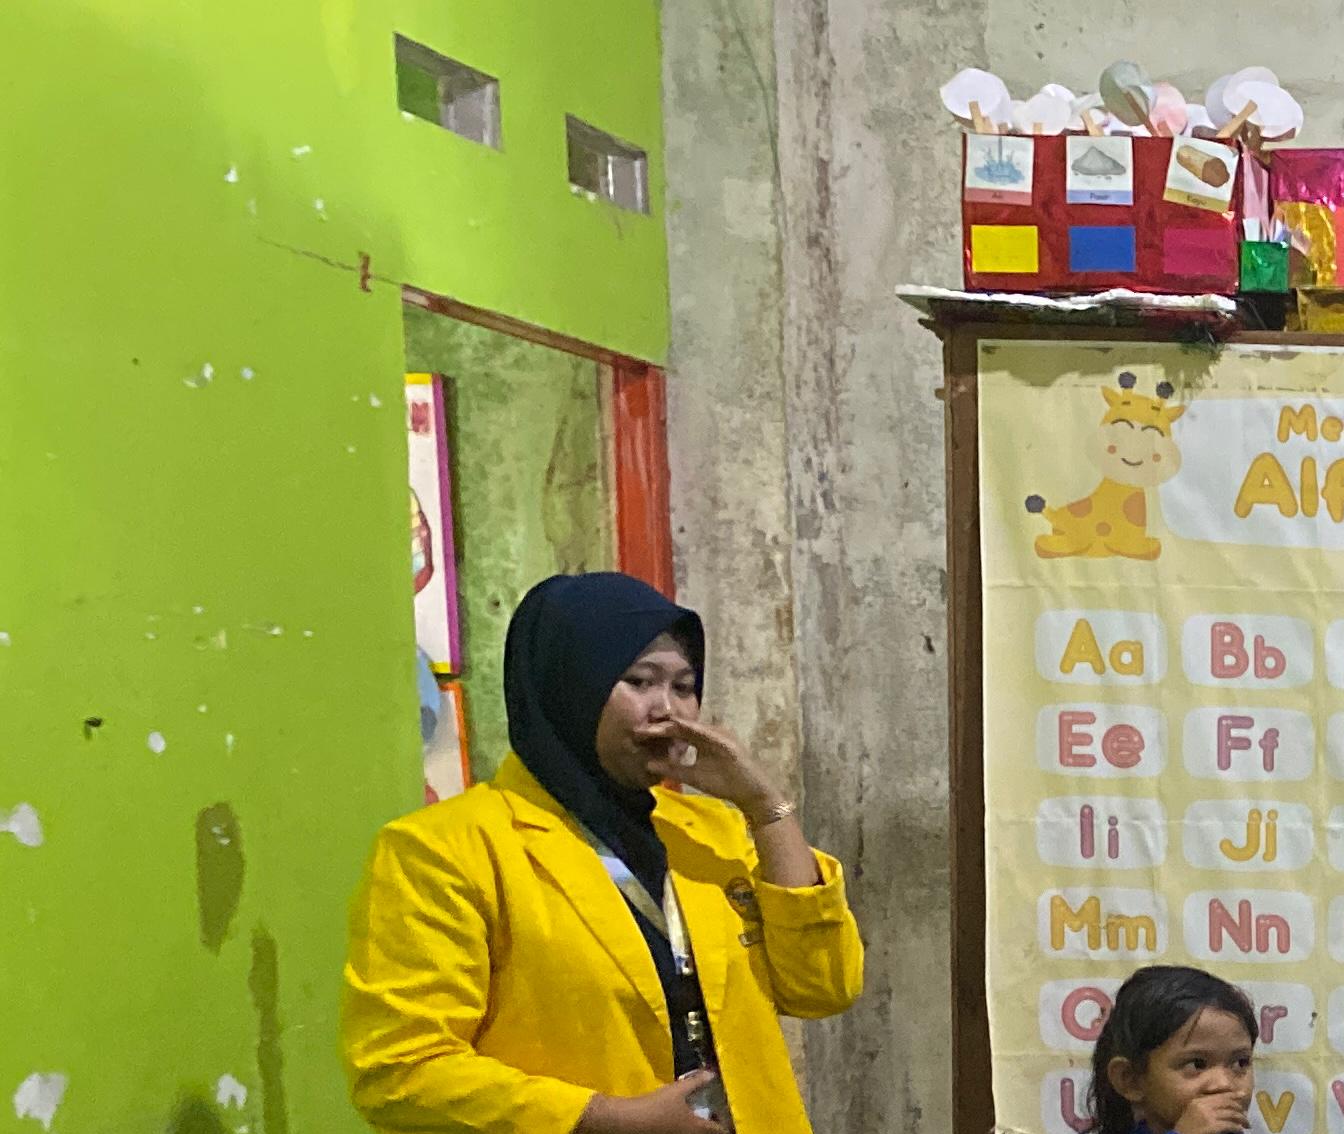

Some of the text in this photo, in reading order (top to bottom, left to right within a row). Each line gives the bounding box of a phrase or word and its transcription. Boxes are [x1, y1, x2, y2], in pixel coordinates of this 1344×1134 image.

[1059, 618, 1145, 675] Aa
[1210, 622, 1287, 680] Bb
[1058, 712, 1145, 769] Ee
[1217, 716, 1280, 772] Ff
[1080, 804, 1121, 860] Ii
[1219, 808, 1278, 862] Jj
[1049, 895, 1157, 953] Mm
[1208, 899, 1291, 955] Nn
[1061, 987, 1114, 1042] Q
